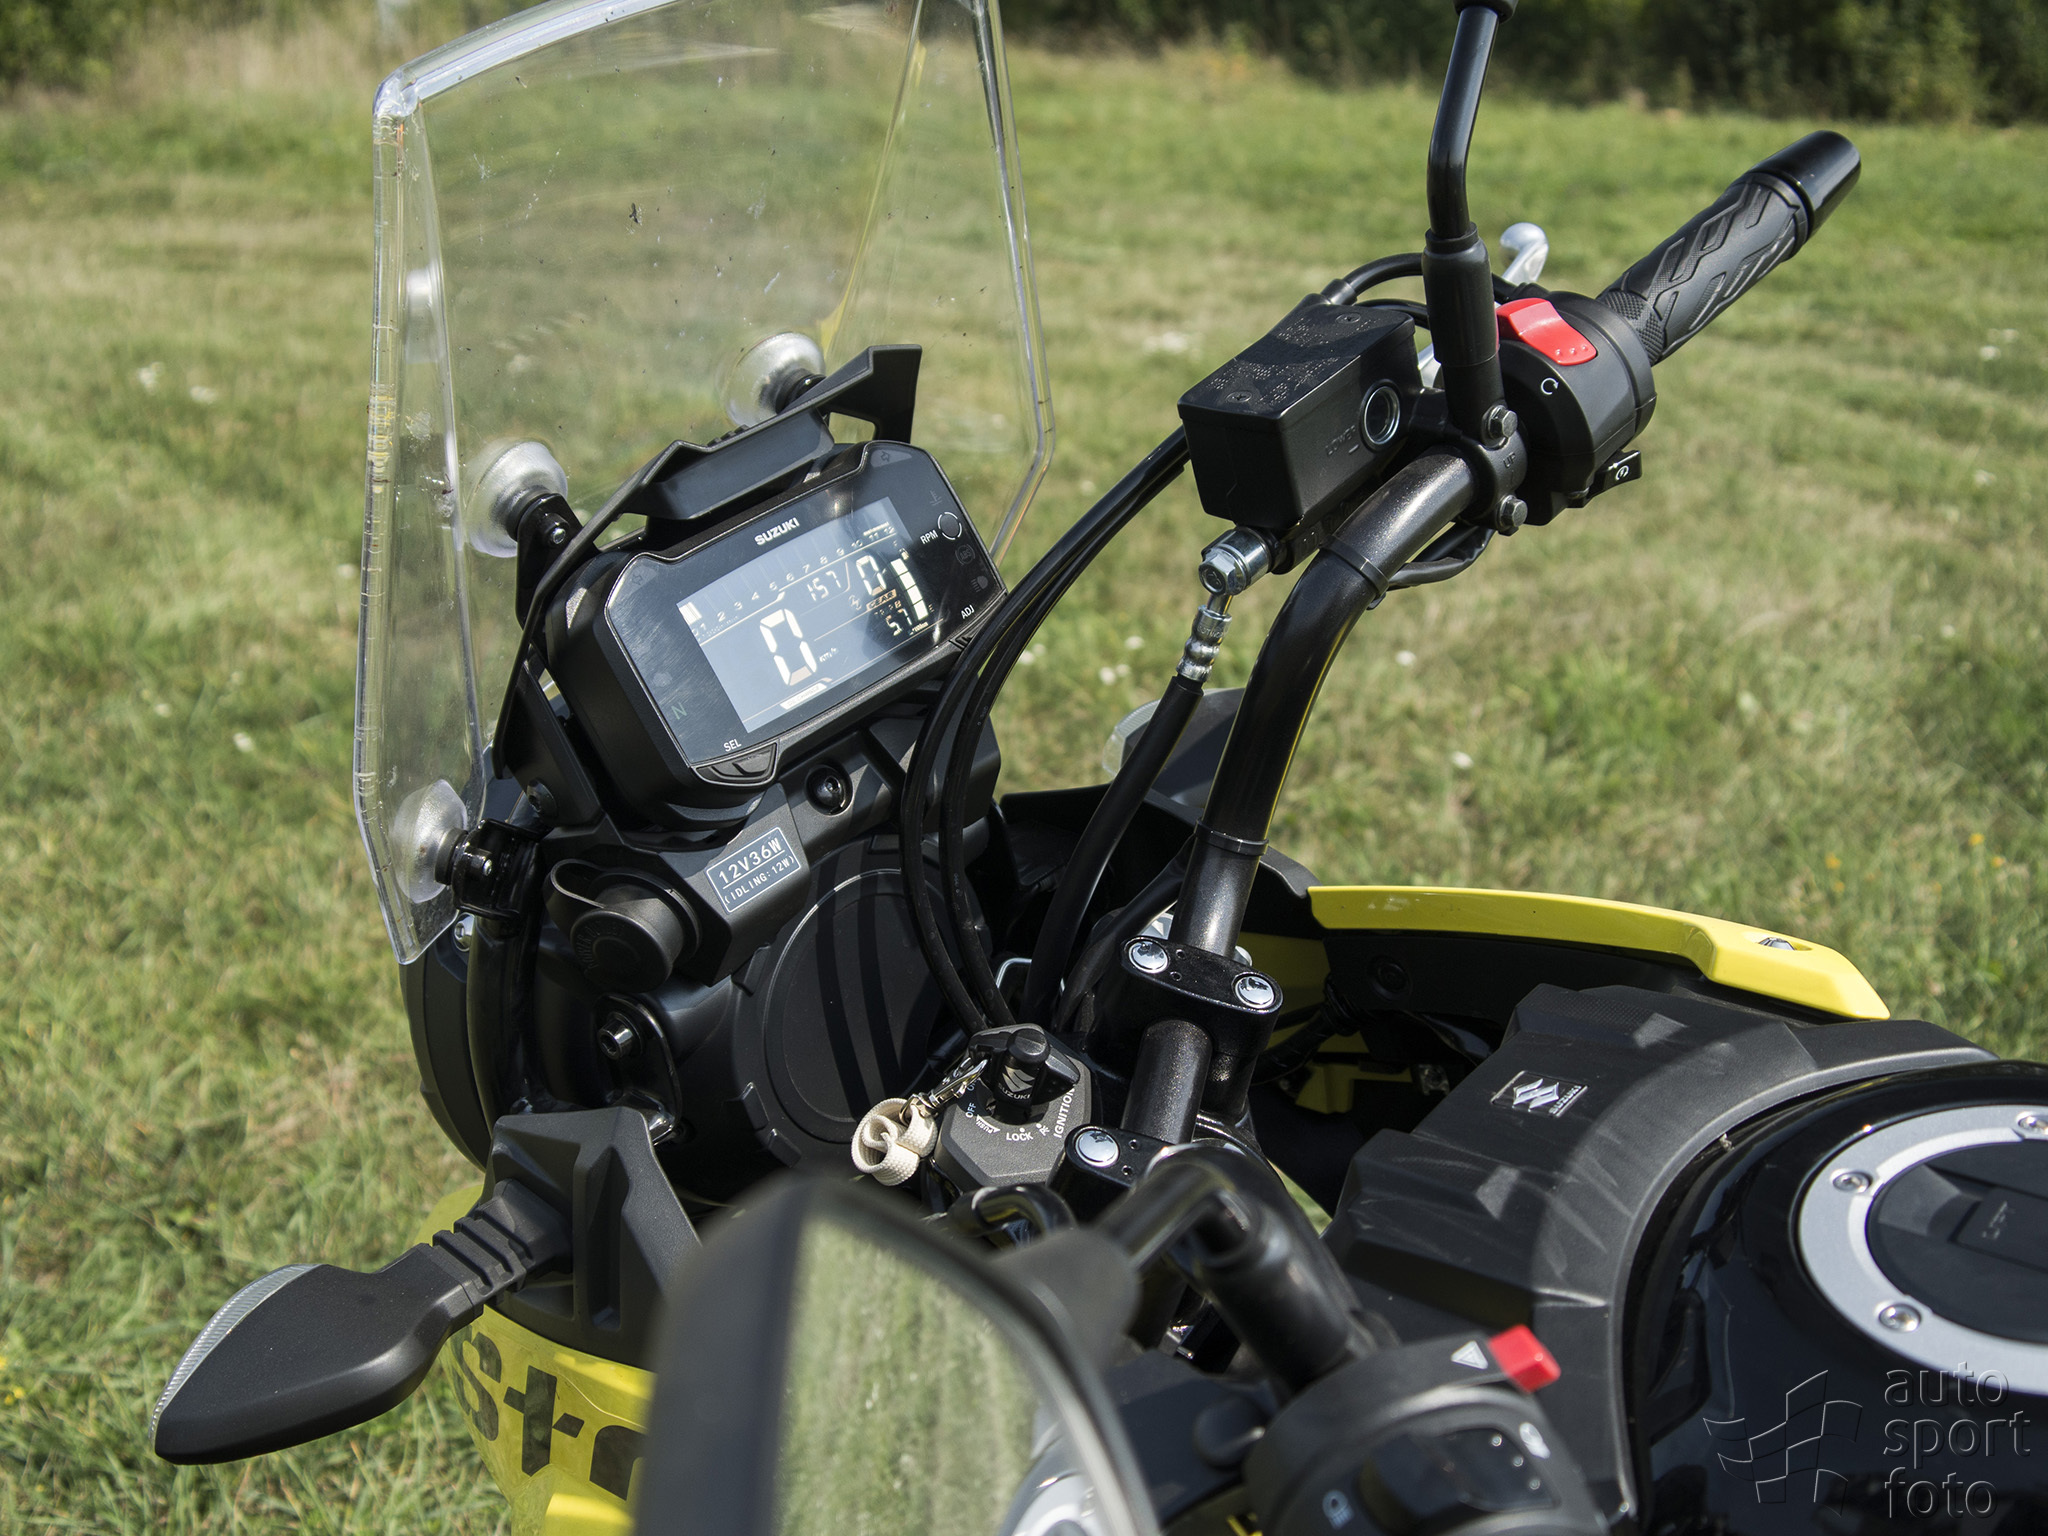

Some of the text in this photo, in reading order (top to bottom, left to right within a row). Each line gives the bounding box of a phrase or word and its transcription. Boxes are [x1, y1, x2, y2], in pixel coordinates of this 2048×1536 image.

[754, 517, 800, 547] SUZUKI
[919, 529, 939, 545] RPM
[717, 611, 726, 622] 2
[734, 601, 743, 611] 3
[751, 591, 760, 601] 4
[769, 581, 778, 591] 5
[802, 563, 811, 573] 7
[960, 604, 975, 620] ADJ
[759, 608, 818, 687] 0
[671, 702, 688, 720] N
[723, 738, 742, 752] SEL
[719, 837, 782, 884] 12V36W
[965, 1102, 977, 1118] OFF
[1006, 1132, 1034, 1142] LOCK
